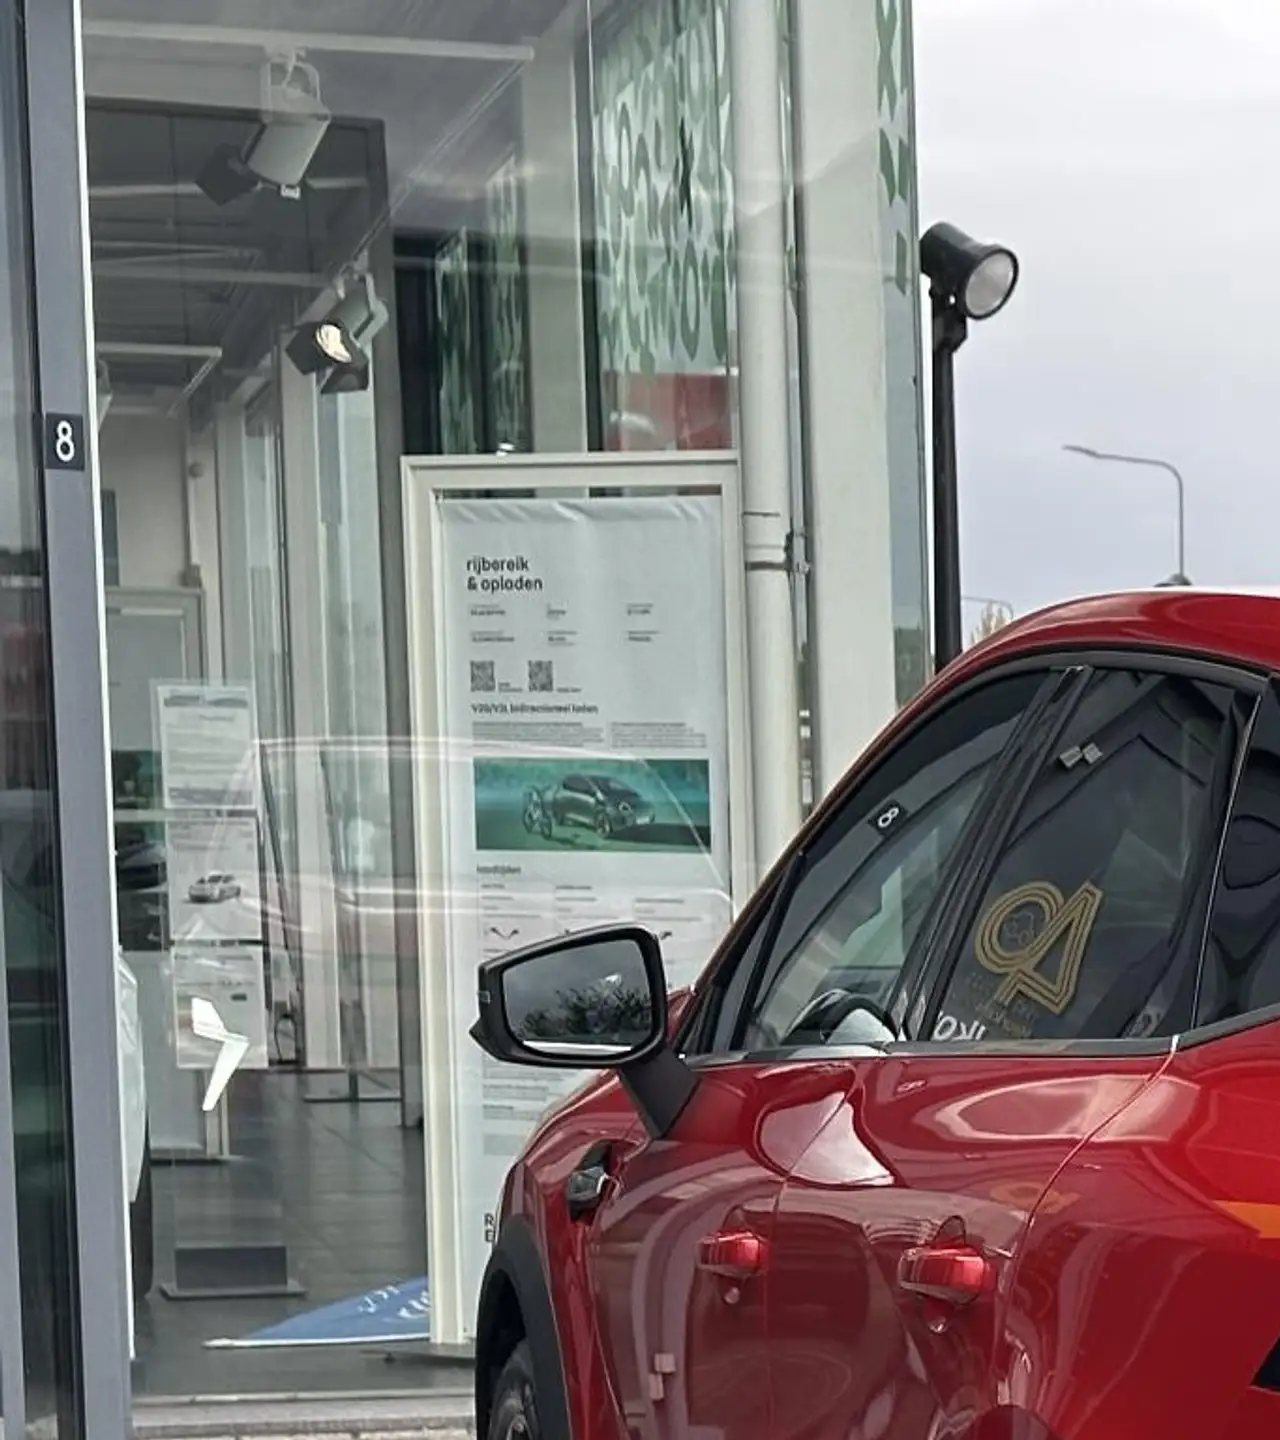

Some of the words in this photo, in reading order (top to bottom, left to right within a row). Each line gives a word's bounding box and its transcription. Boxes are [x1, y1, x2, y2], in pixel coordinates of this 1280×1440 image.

[56, 420, 75, 462] 8
[466, 555, 529, 575] rijbereik
[467, 576, 477, 590] &
[481, 575, 543, 594] opladen
